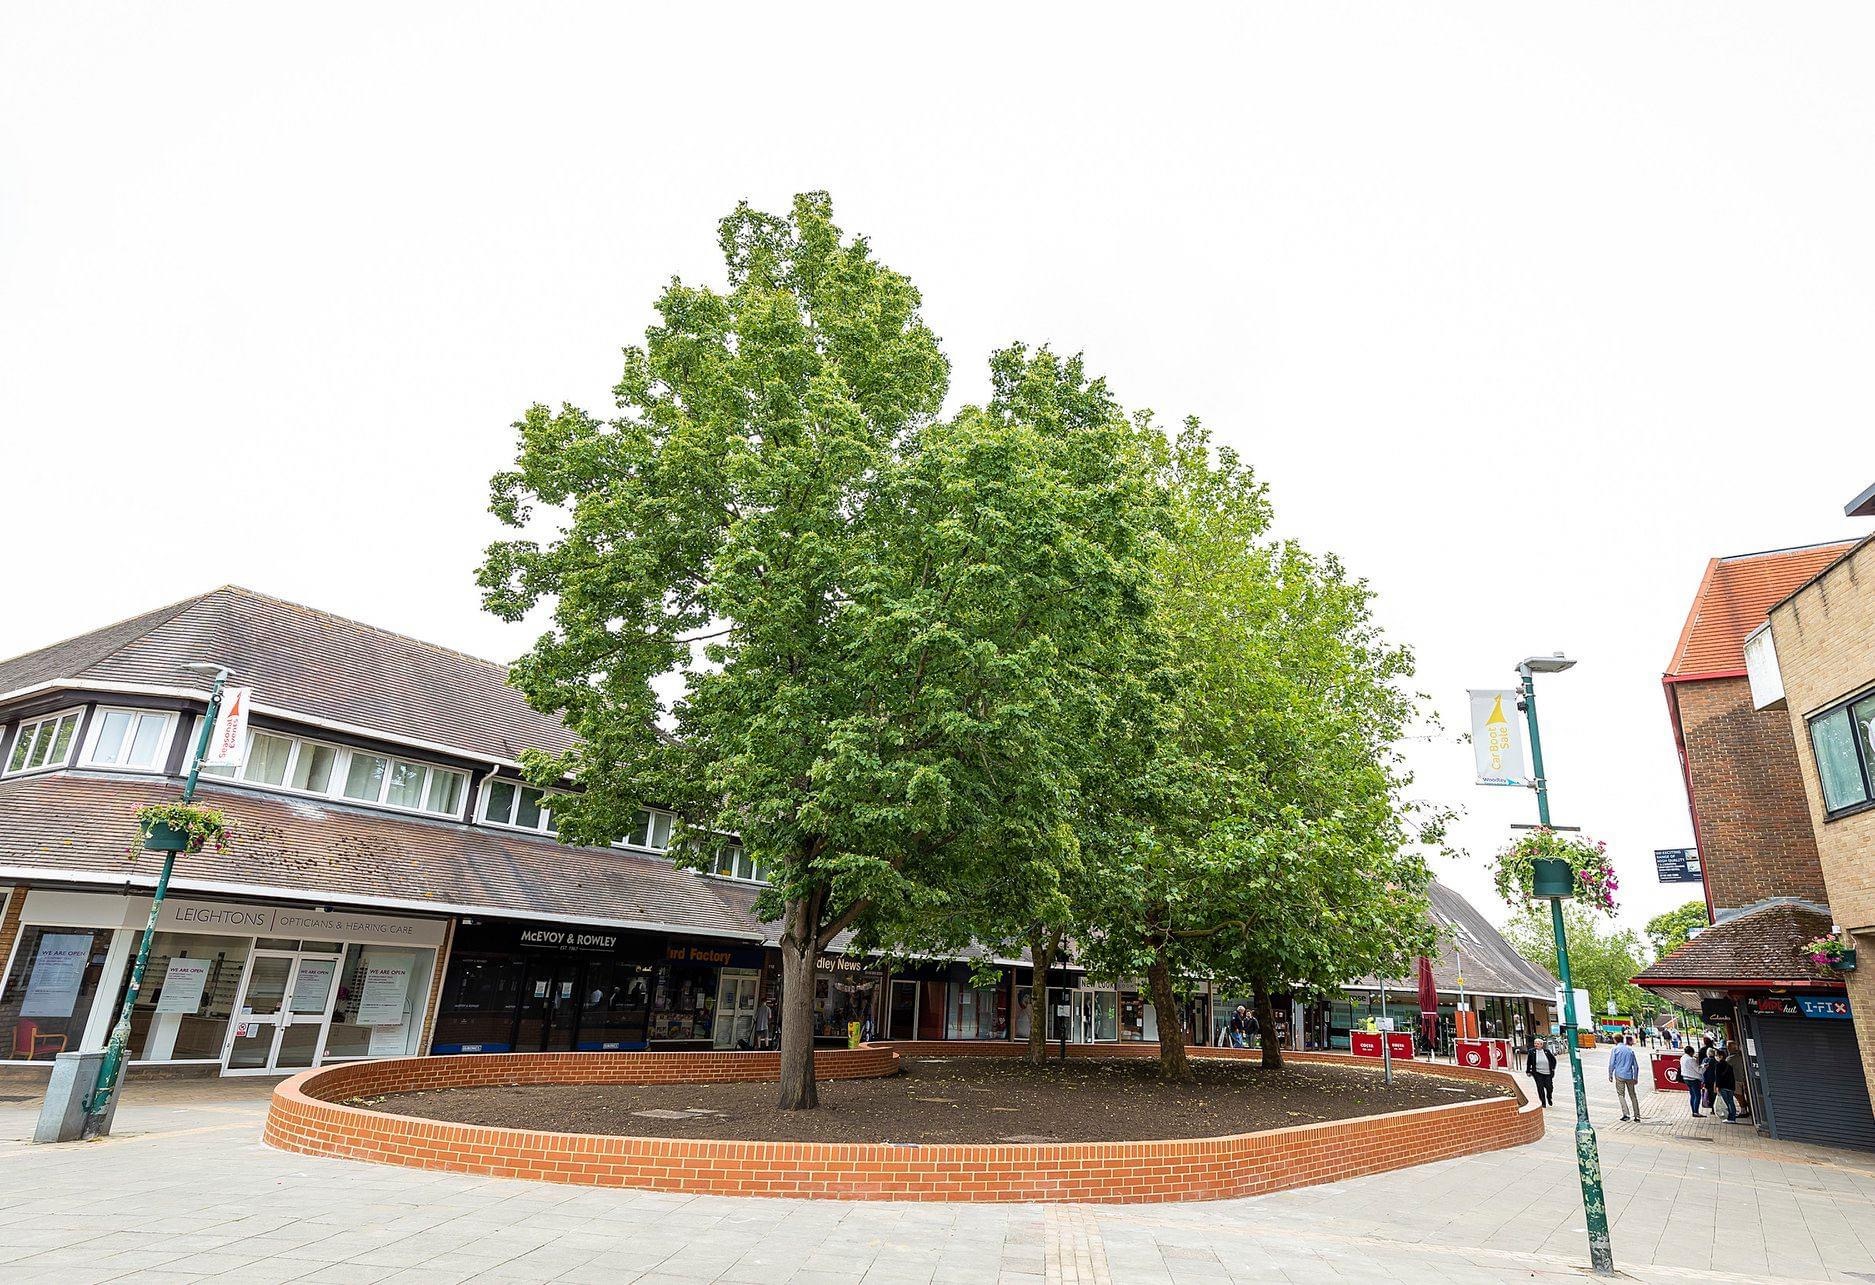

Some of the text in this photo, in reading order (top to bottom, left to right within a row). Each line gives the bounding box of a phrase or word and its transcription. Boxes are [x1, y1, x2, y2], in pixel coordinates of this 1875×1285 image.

[218, 718, 233, 759] Seasonal
[228, 718, 240, 749] Events
[1500, 727, 1509, 750] Sale
[175, 907, 265, 926] LEIGHTONS
[280, 917, 413, 935] OPTICIANS & HEARING CARE
[520, 930, 617, 947] McEVOY & ROWLEY
[690, 948, 731, 965] Factory
[837, 959, 861, 971] News
[1783, 1004, 1797, 1014] hut
[1804, 1001, 1847, 1014] I-FIX
[1709, 1013, 1731, 1021] Clarks
